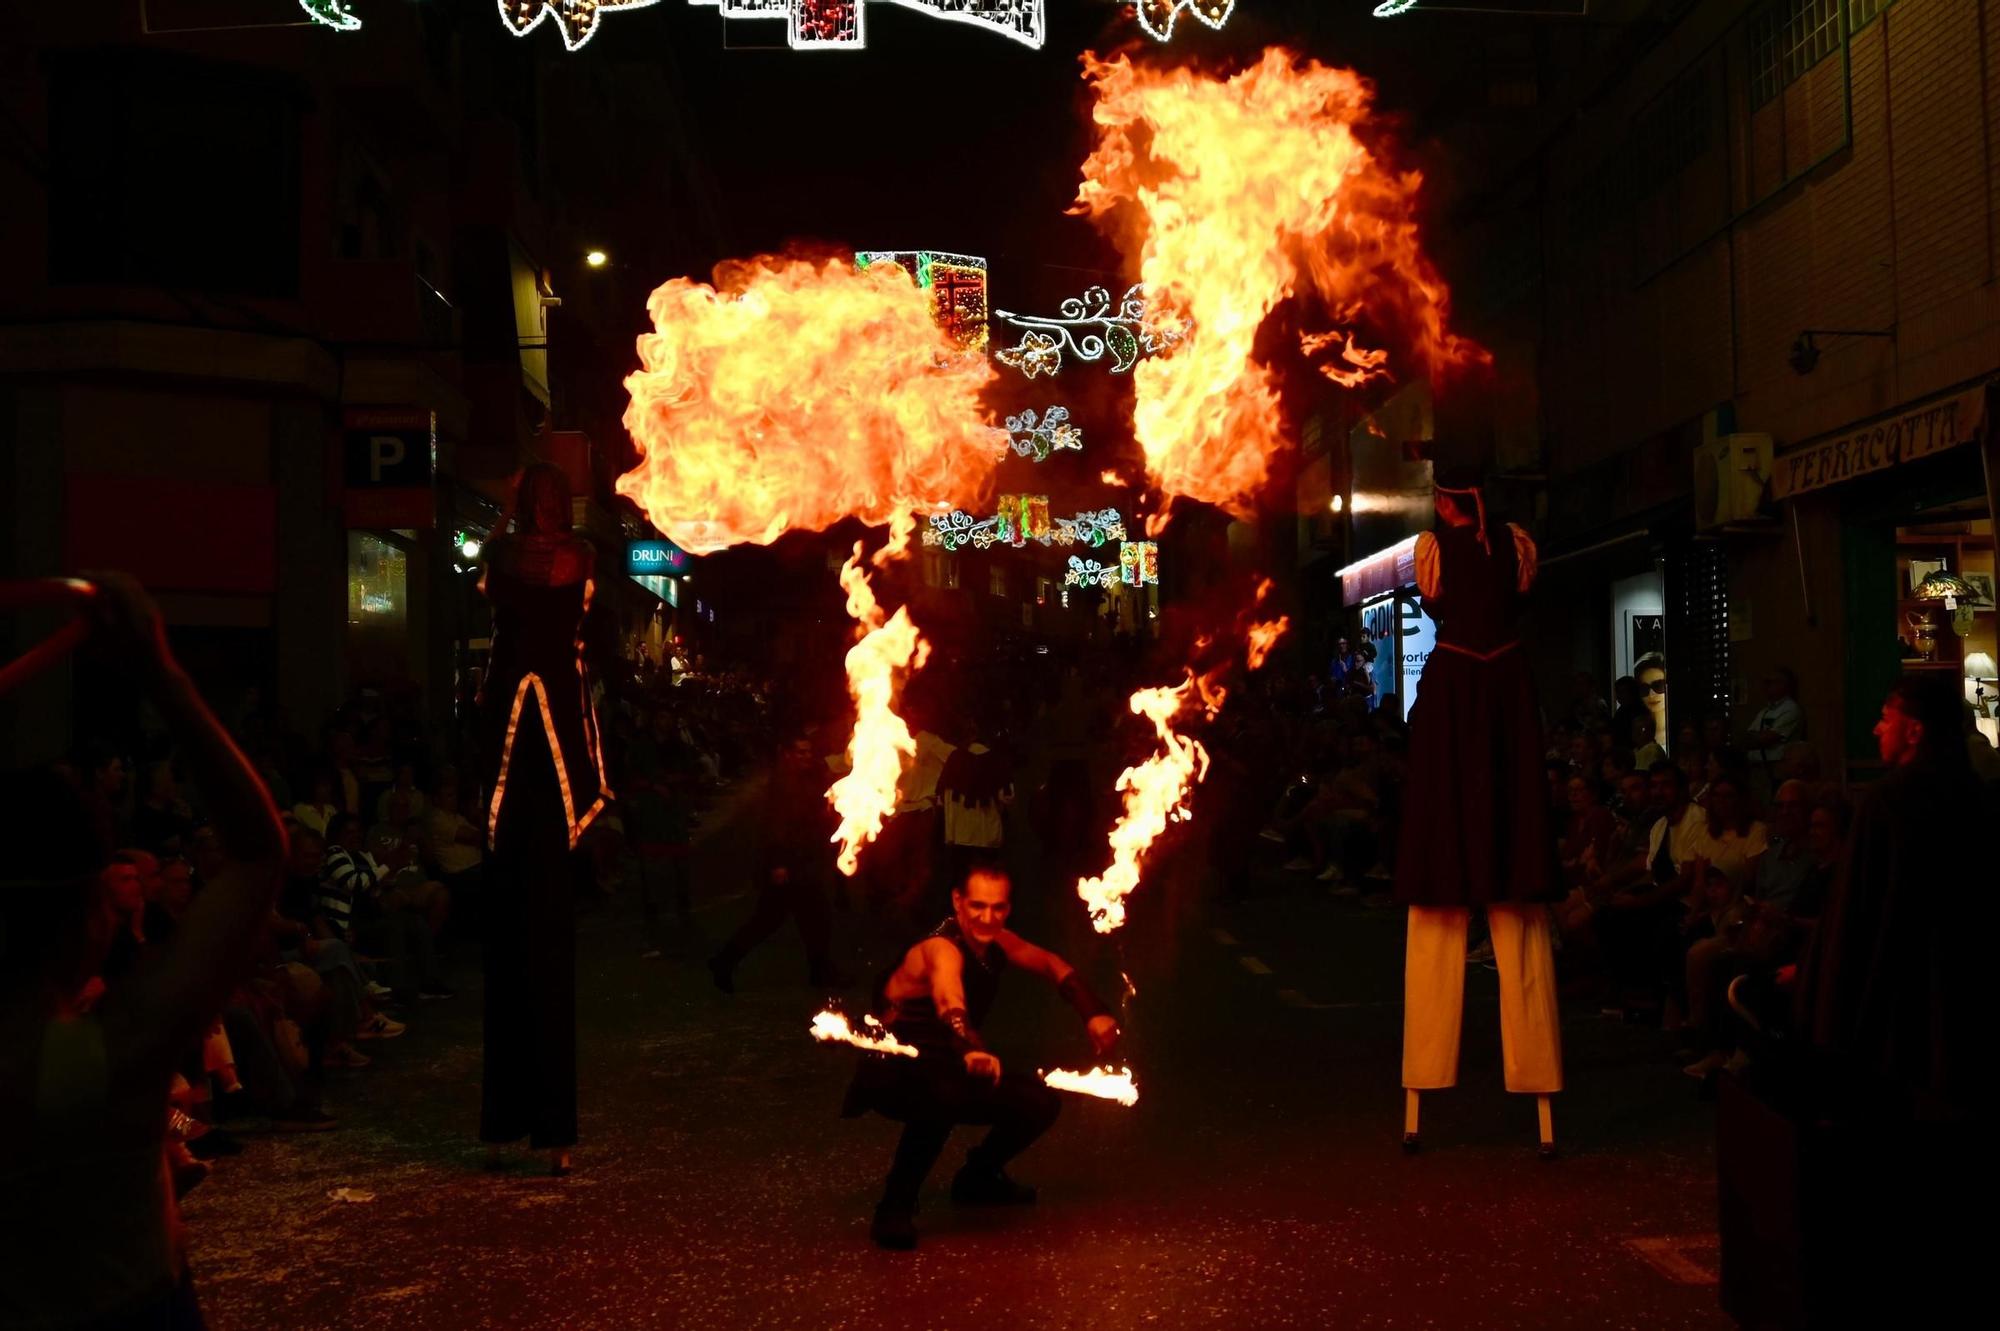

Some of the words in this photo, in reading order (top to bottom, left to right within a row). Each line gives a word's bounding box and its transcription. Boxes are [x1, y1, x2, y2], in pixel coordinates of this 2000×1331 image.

[370, 436, 407, 482] P
[1789, 402, 1959, 492] TERRACOTTA
[632, 550, 673, 561] DRUNI
